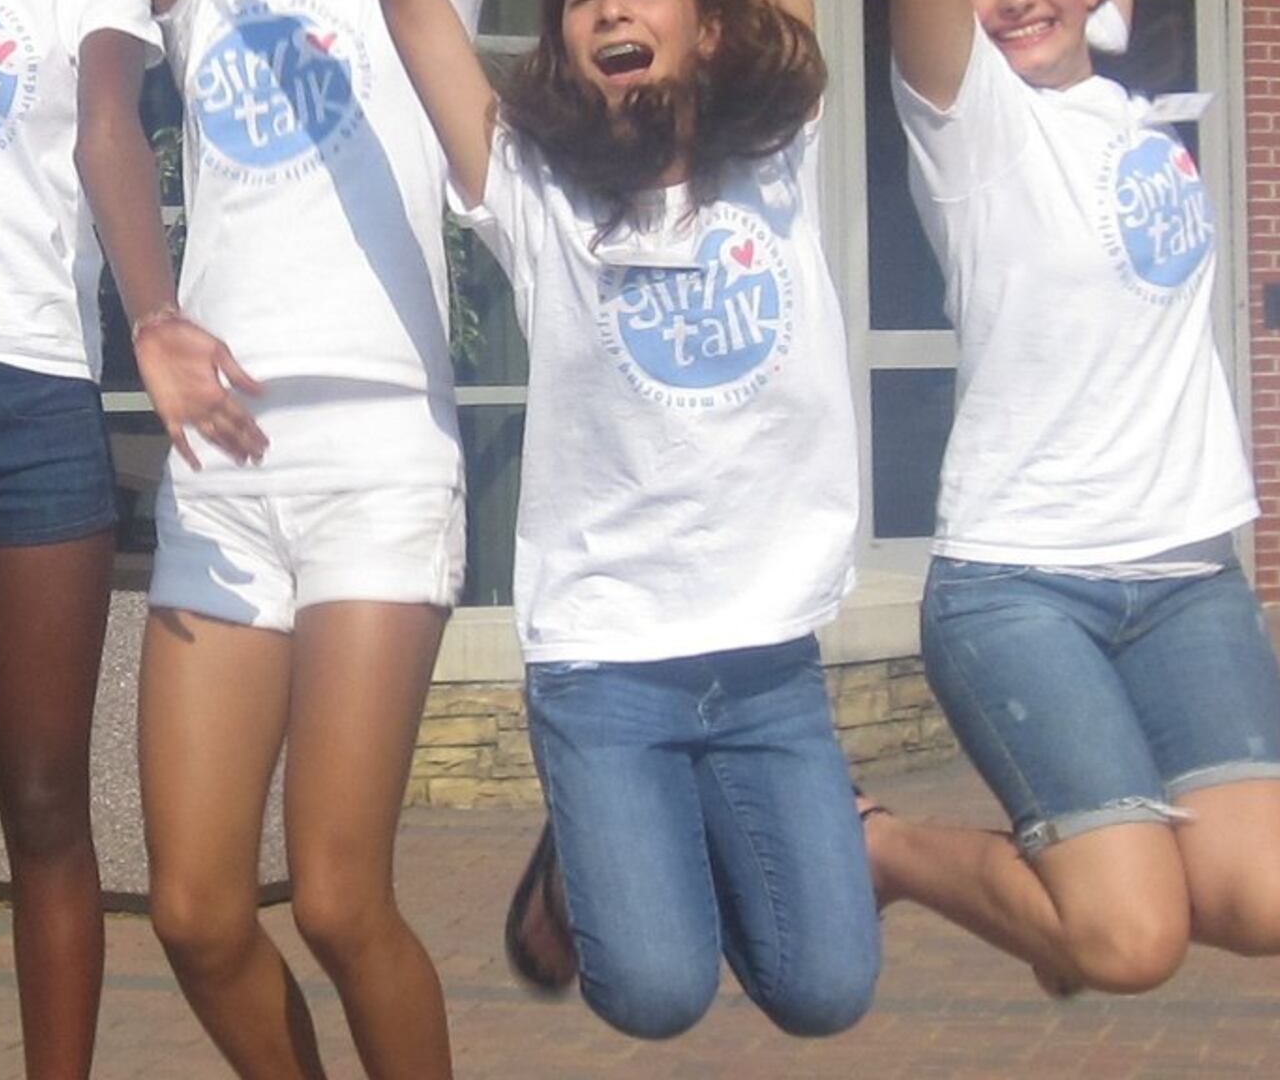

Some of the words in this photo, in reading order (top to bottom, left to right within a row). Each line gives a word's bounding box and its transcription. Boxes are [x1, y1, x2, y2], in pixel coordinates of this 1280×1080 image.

[194, 38, 290, 114] girl
[234, 68, 349, 148] talk
[1116, 161, 1179, 229] girl
[1147, 189, 1215, 265] talk
[617, 259, 719, 331] girl
[662, 285, 779, 367] talk
